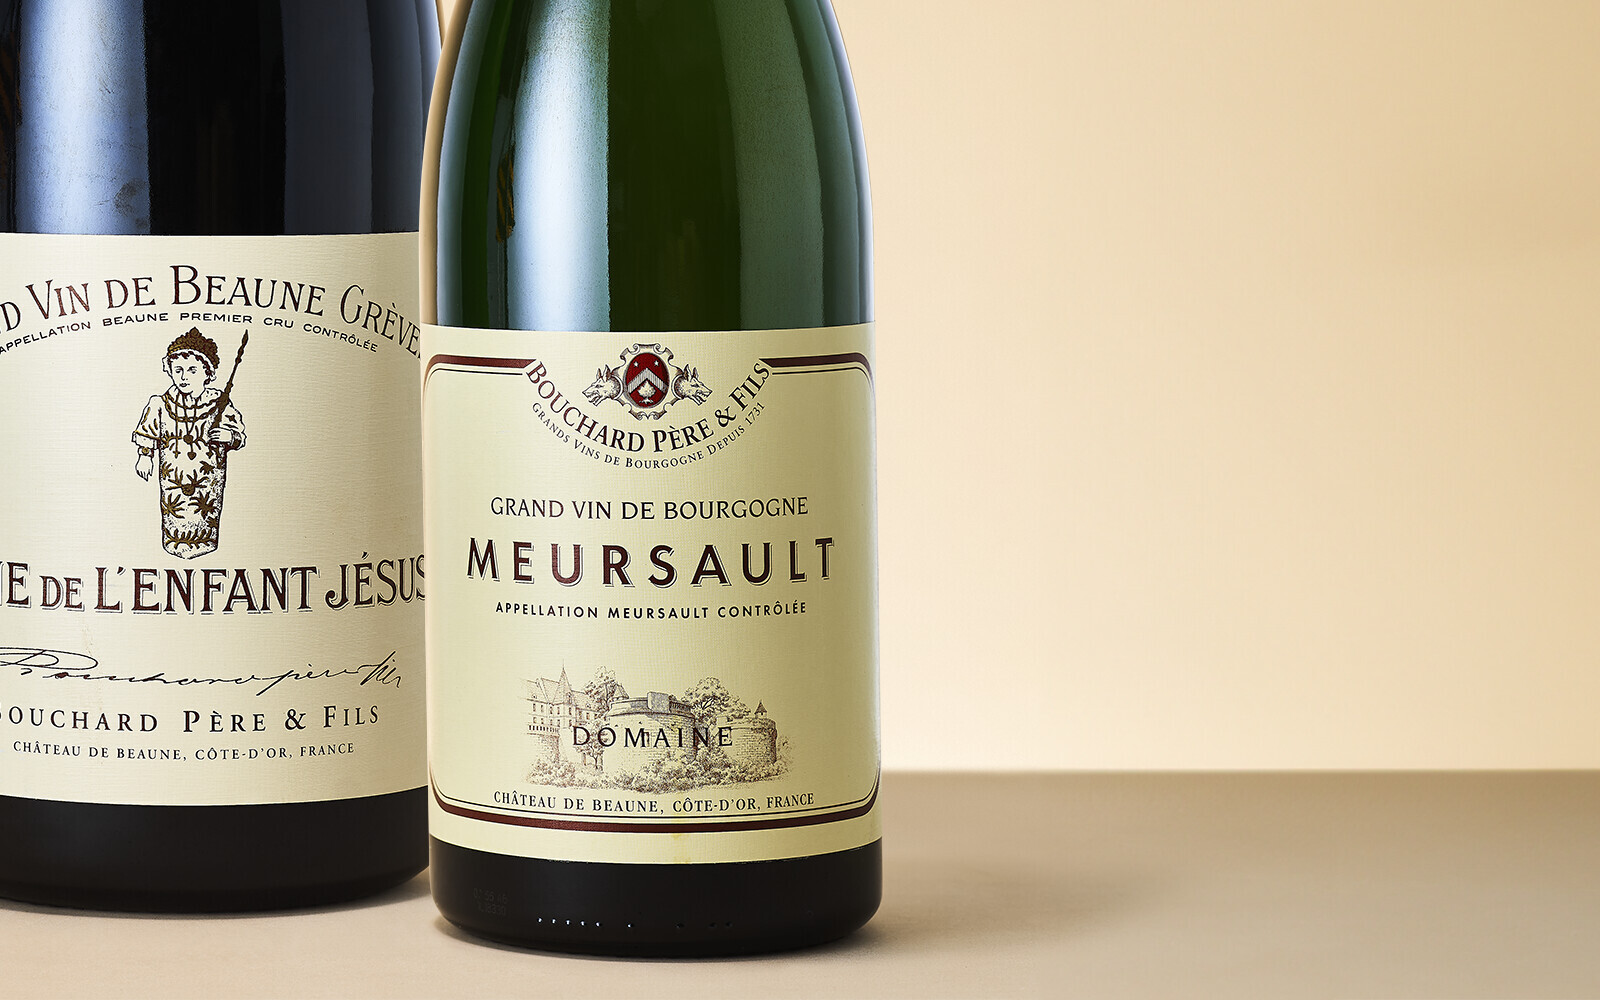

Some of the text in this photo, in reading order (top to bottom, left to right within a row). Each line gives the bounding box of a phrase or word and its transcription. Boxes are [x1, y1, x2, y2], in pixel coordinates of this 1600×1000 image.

[25, 278, 92, 321] VIN
[105, 276, 157, 310] DE
[170, 264, 326, 317] BEAUNE
[340, 284, 420, 359] GRÈVE
[101, 312, 169, 327] BEAUNE
[180, 312, 253, 324] PREMIER
[263, 317, 295, 330] CRU
[303, 322, 378, 353] CONTRÔLÉE
[526, 360, 770, 453] BOUCHARD PÈRE & FILS
[531, 402, 766, 470] GRANDS VINS DE BOURGOGNE DEPUIS 1731
[490, 496, 809, 521] GRAND VIN DE BOURGOGNE
[467, 537, 834, 588] MEURSAULT
[40, 575, 85, 611] DE
[94, 565, 321, 615] L'ENFANT
[325, 551, 425, 611] JÉSUS
[495, 600, 807, 620] APPELLATION MEURSAULT CONTRÔLÉE
[183, 707, 266, 733] PÈRE
[284, 707, 307, 731] &
[323, 704, 379, 728] FILS
[13, 740, 355, 763] CHÂTEAU DE BEAUNE, CÔTE-D'OR, FRANCE
[572, 725, 734, 748] DOMAINE
[494, 789, 815, 816] CHÂTEAU DE BEAUNE, CÔTE-D'OR, FRANCE
